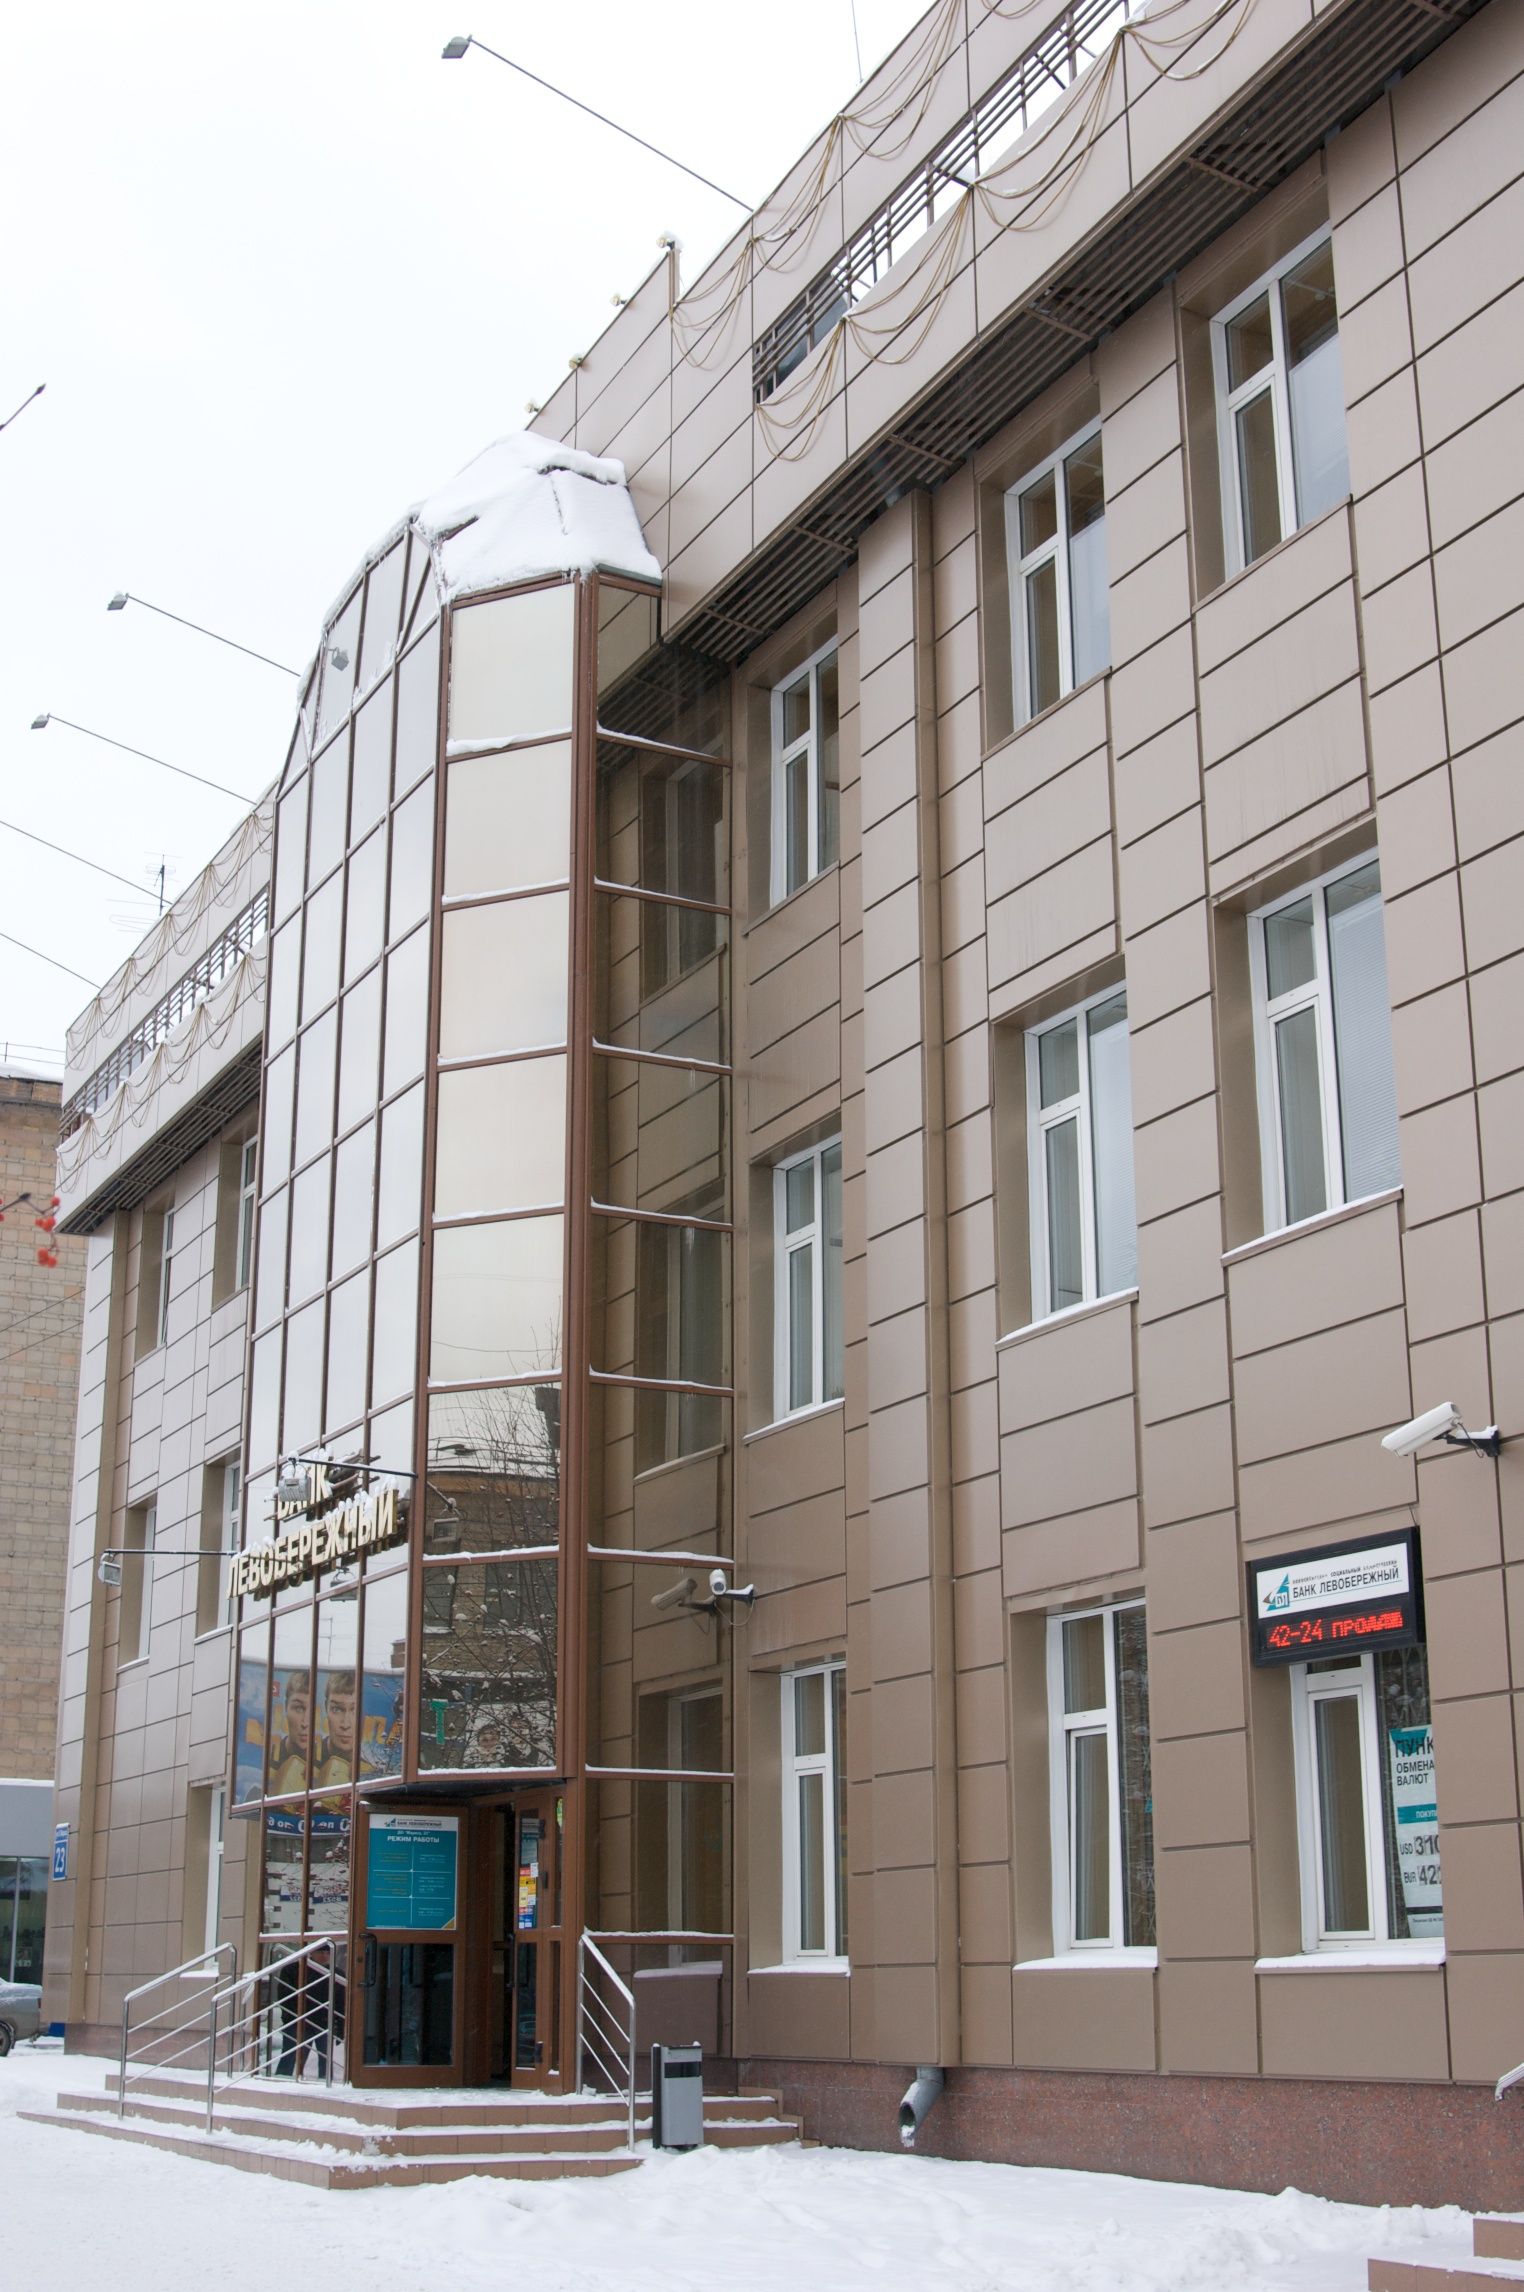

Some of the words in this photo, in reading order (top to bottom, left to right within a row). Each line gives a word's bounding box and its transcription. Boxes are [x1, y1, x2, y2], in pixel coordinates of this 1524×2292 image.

[1293, 1584, 1317, 1598] БАНК
[1319, 1566, 1399, 1593] ЛЕВОБЕРЕЖНЫЙ
[1269, 1618, 1324, 1648] 42-24
[1396, 1760, 1434, 1773] ОБМЕНА
[1397, 1773, 1428, 1786] ВАЛЮТ
[1400, 1843, 1413, 1855] USD
[55, 1847, 65, 1873] 23
